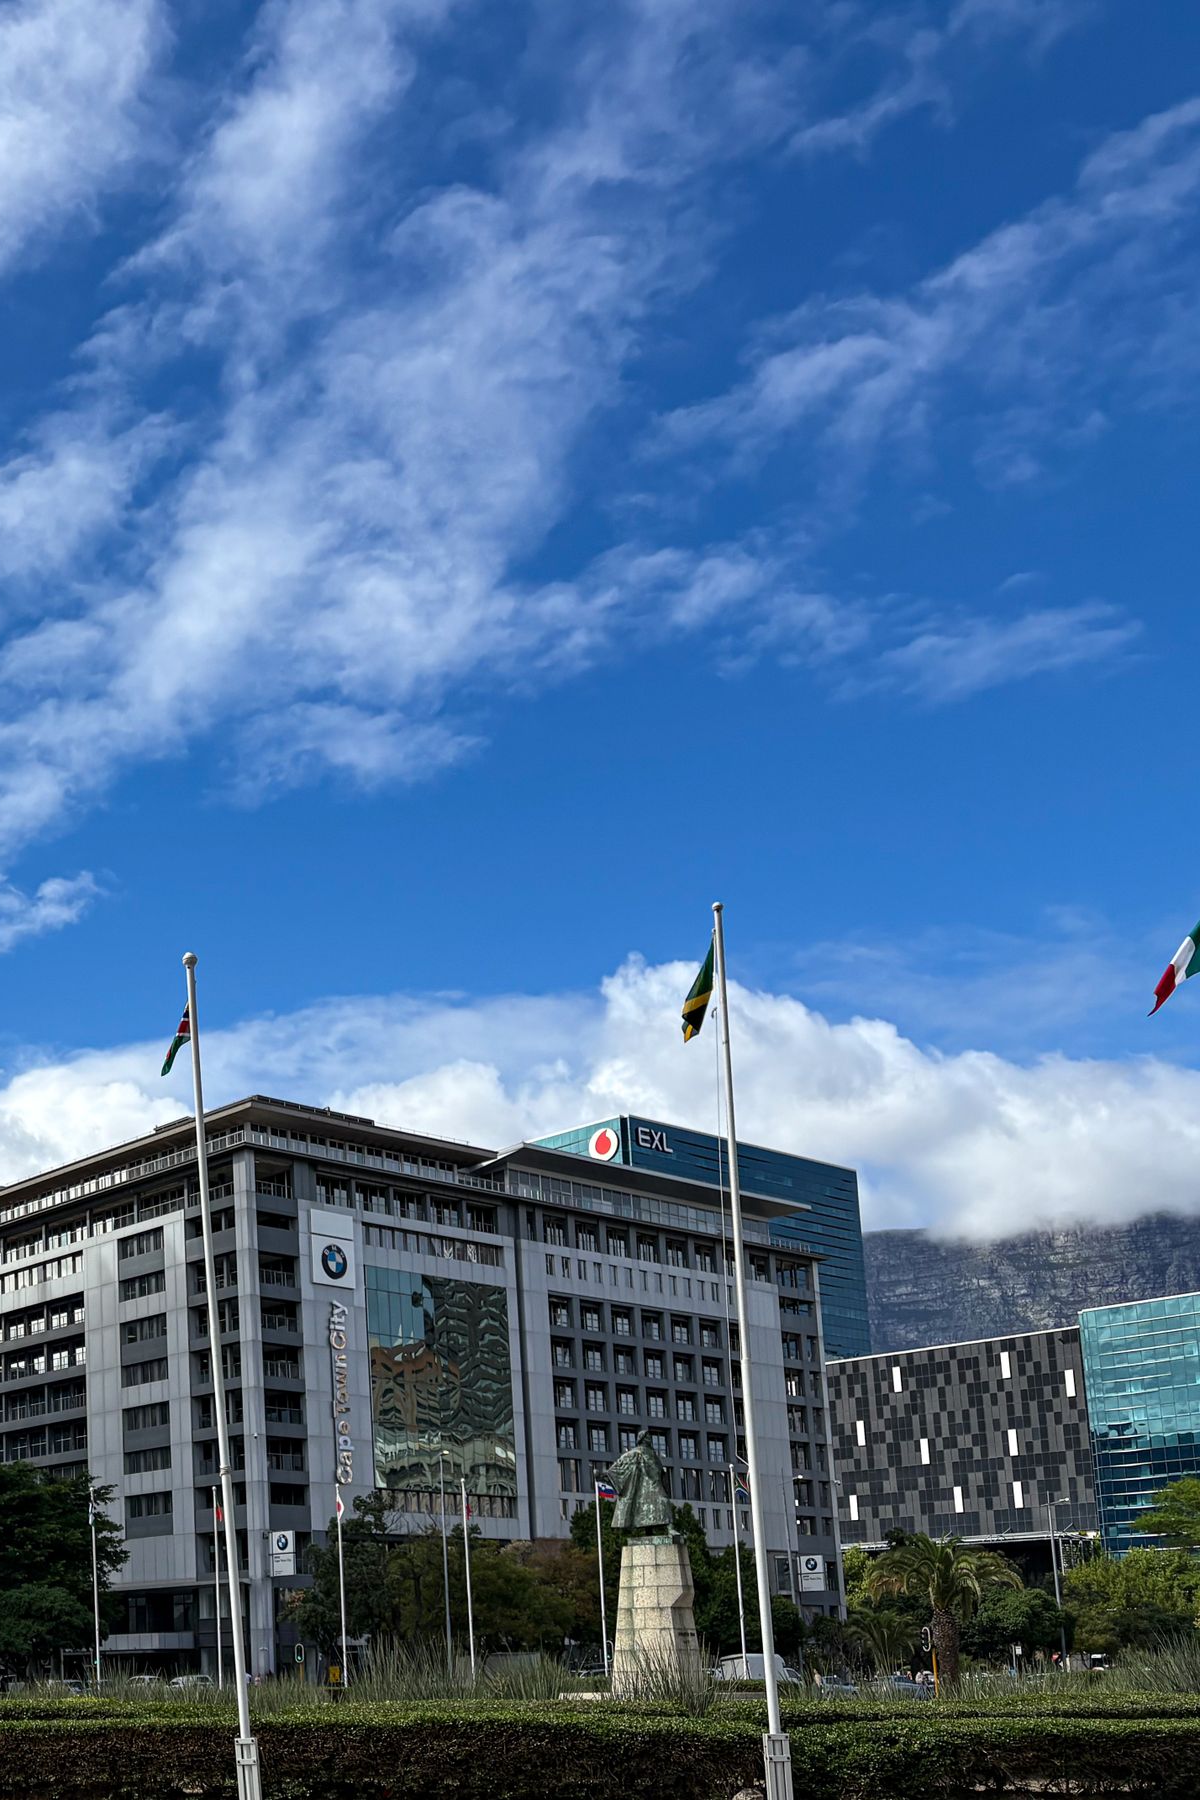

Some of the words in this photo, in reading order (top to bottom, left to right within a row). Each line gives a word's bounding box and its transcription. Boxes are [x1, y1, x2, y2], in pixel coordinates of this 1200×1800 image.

[637, 1126, 674, 1154] EXL
[329, 1300, 348, 1350] City
[332, 1354, 351, 1419] Town
[335, 1420, 354, 1485] Cape
